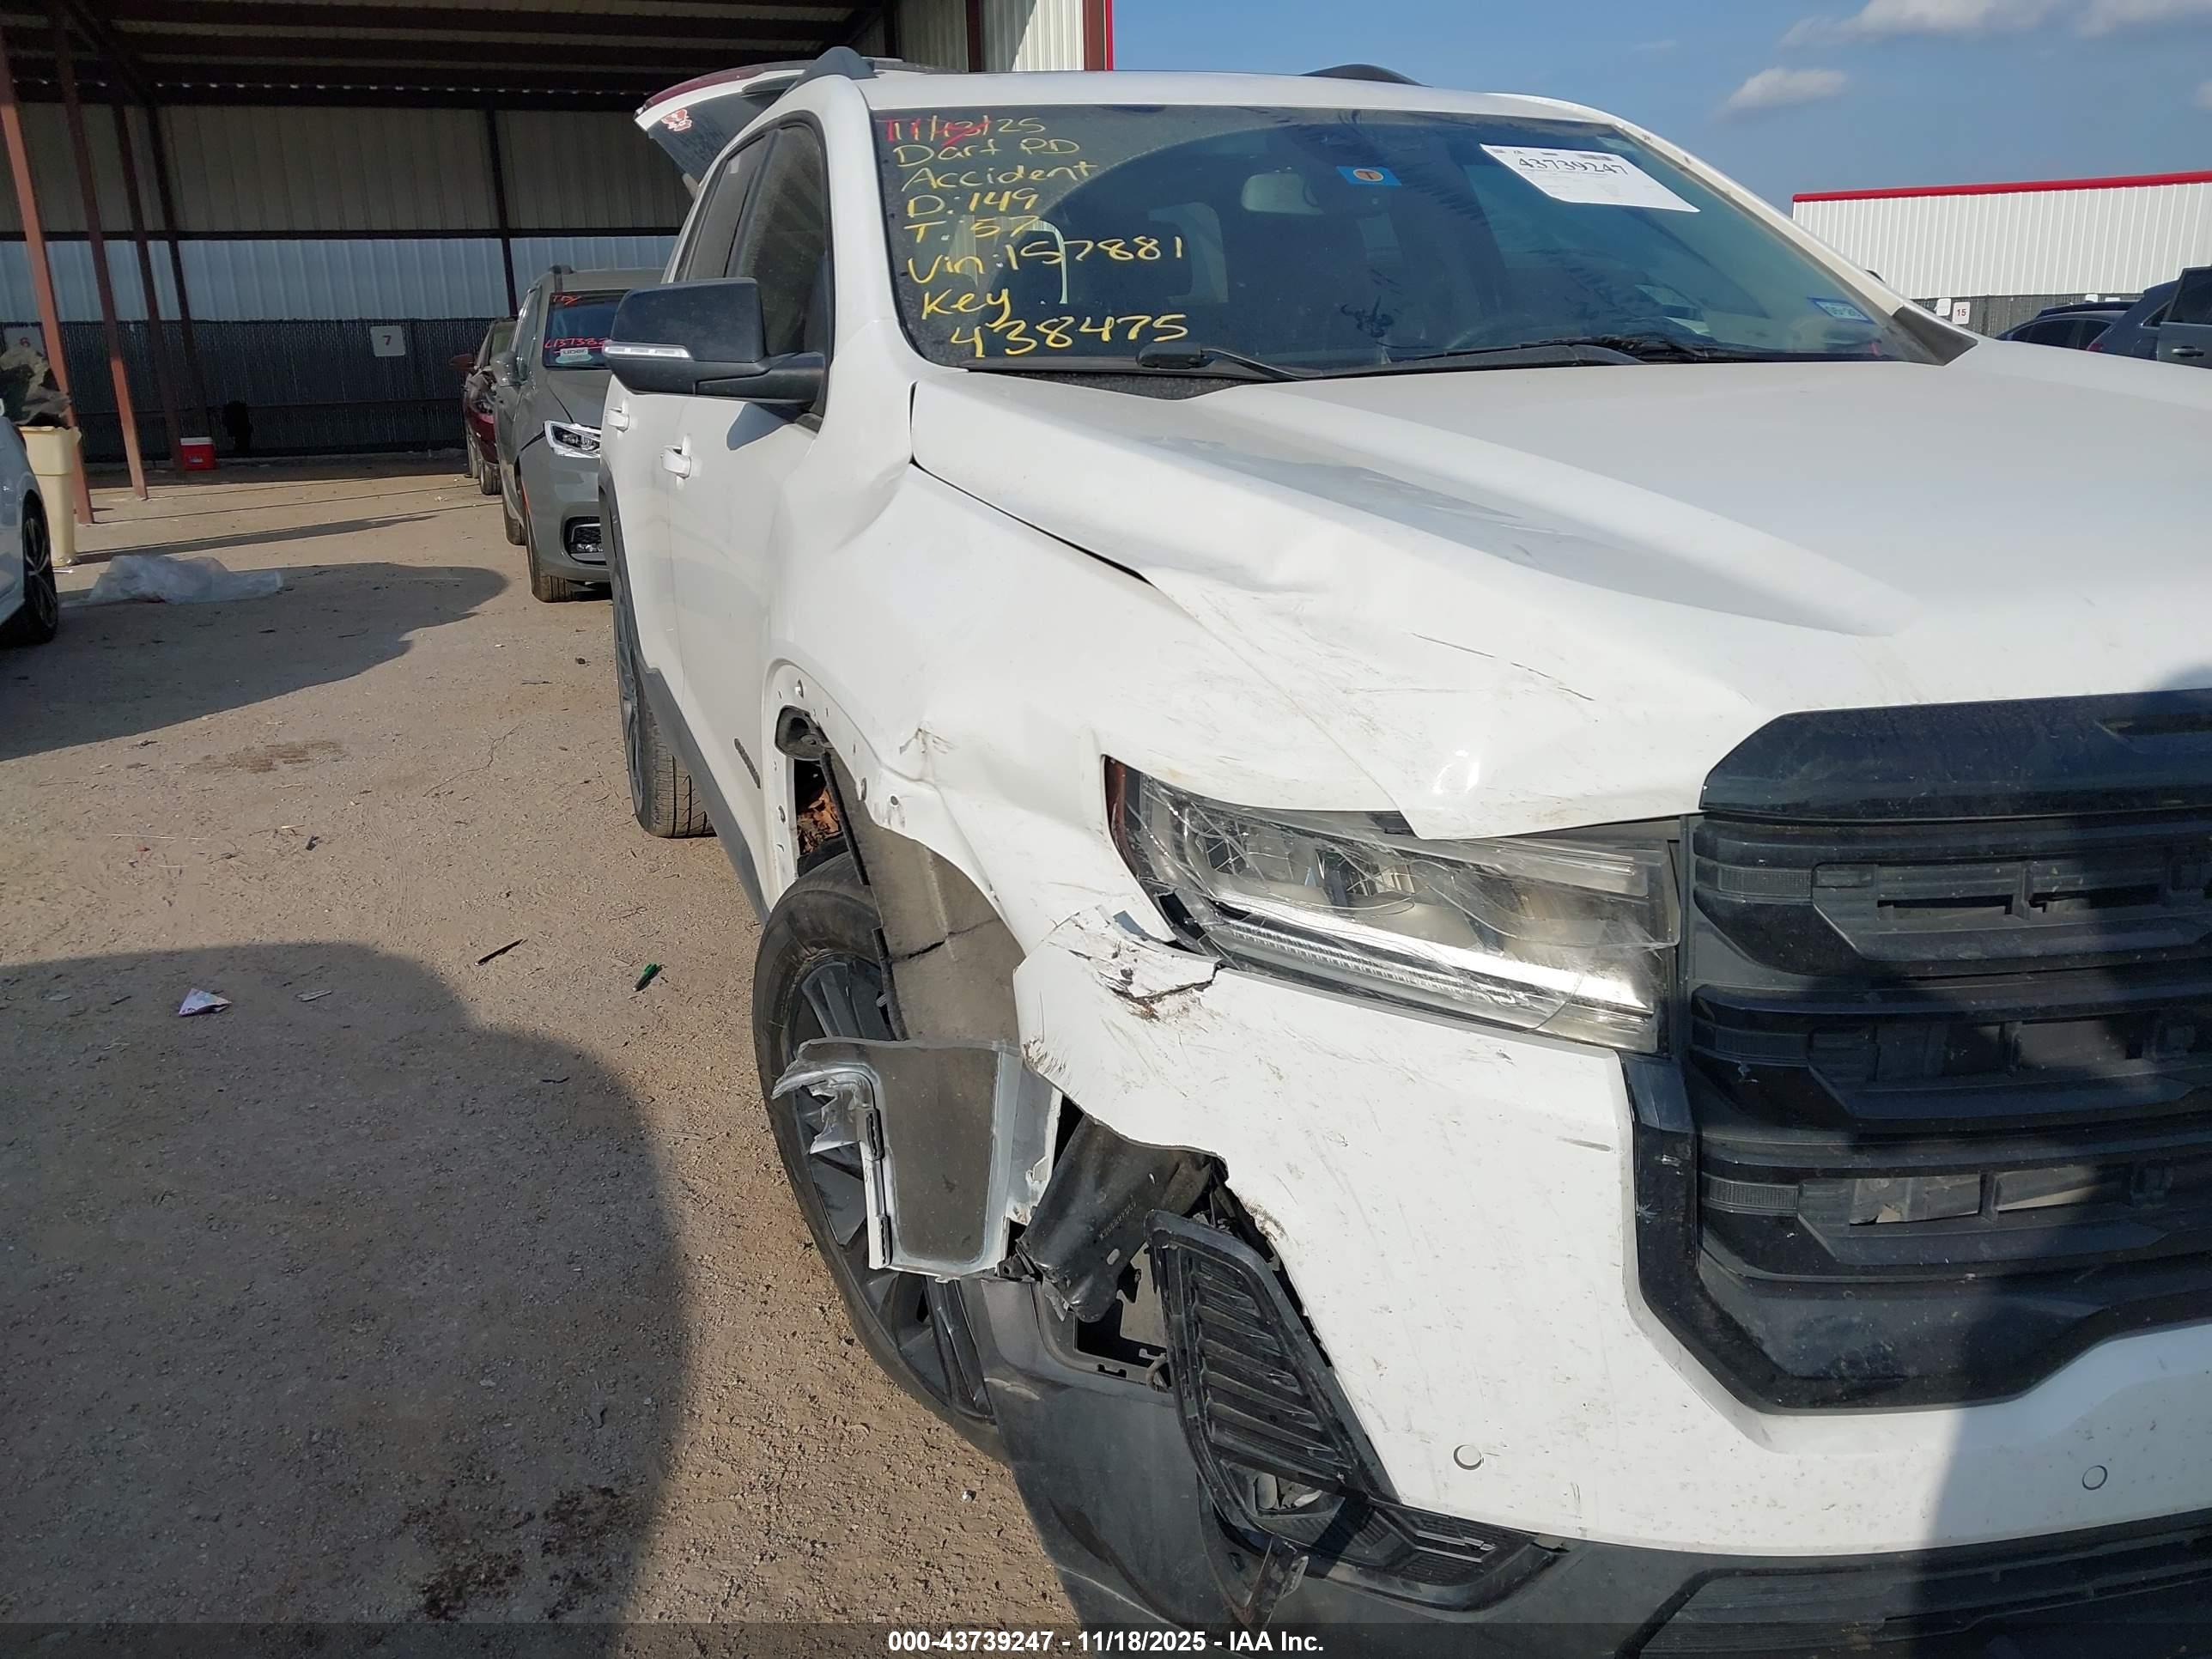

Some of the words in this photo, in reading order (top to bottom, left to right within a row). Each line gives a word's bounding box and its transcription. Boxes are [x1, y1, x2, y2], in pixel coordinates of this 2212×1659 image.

[1518, 157, 1629, 176] 43739247
[901, 161, 1095, 192] Accident
[1957, 308, 1967, 317] 15
[382, 335, 392, 346] 7
[950, 313, 1189, 358] 438475
